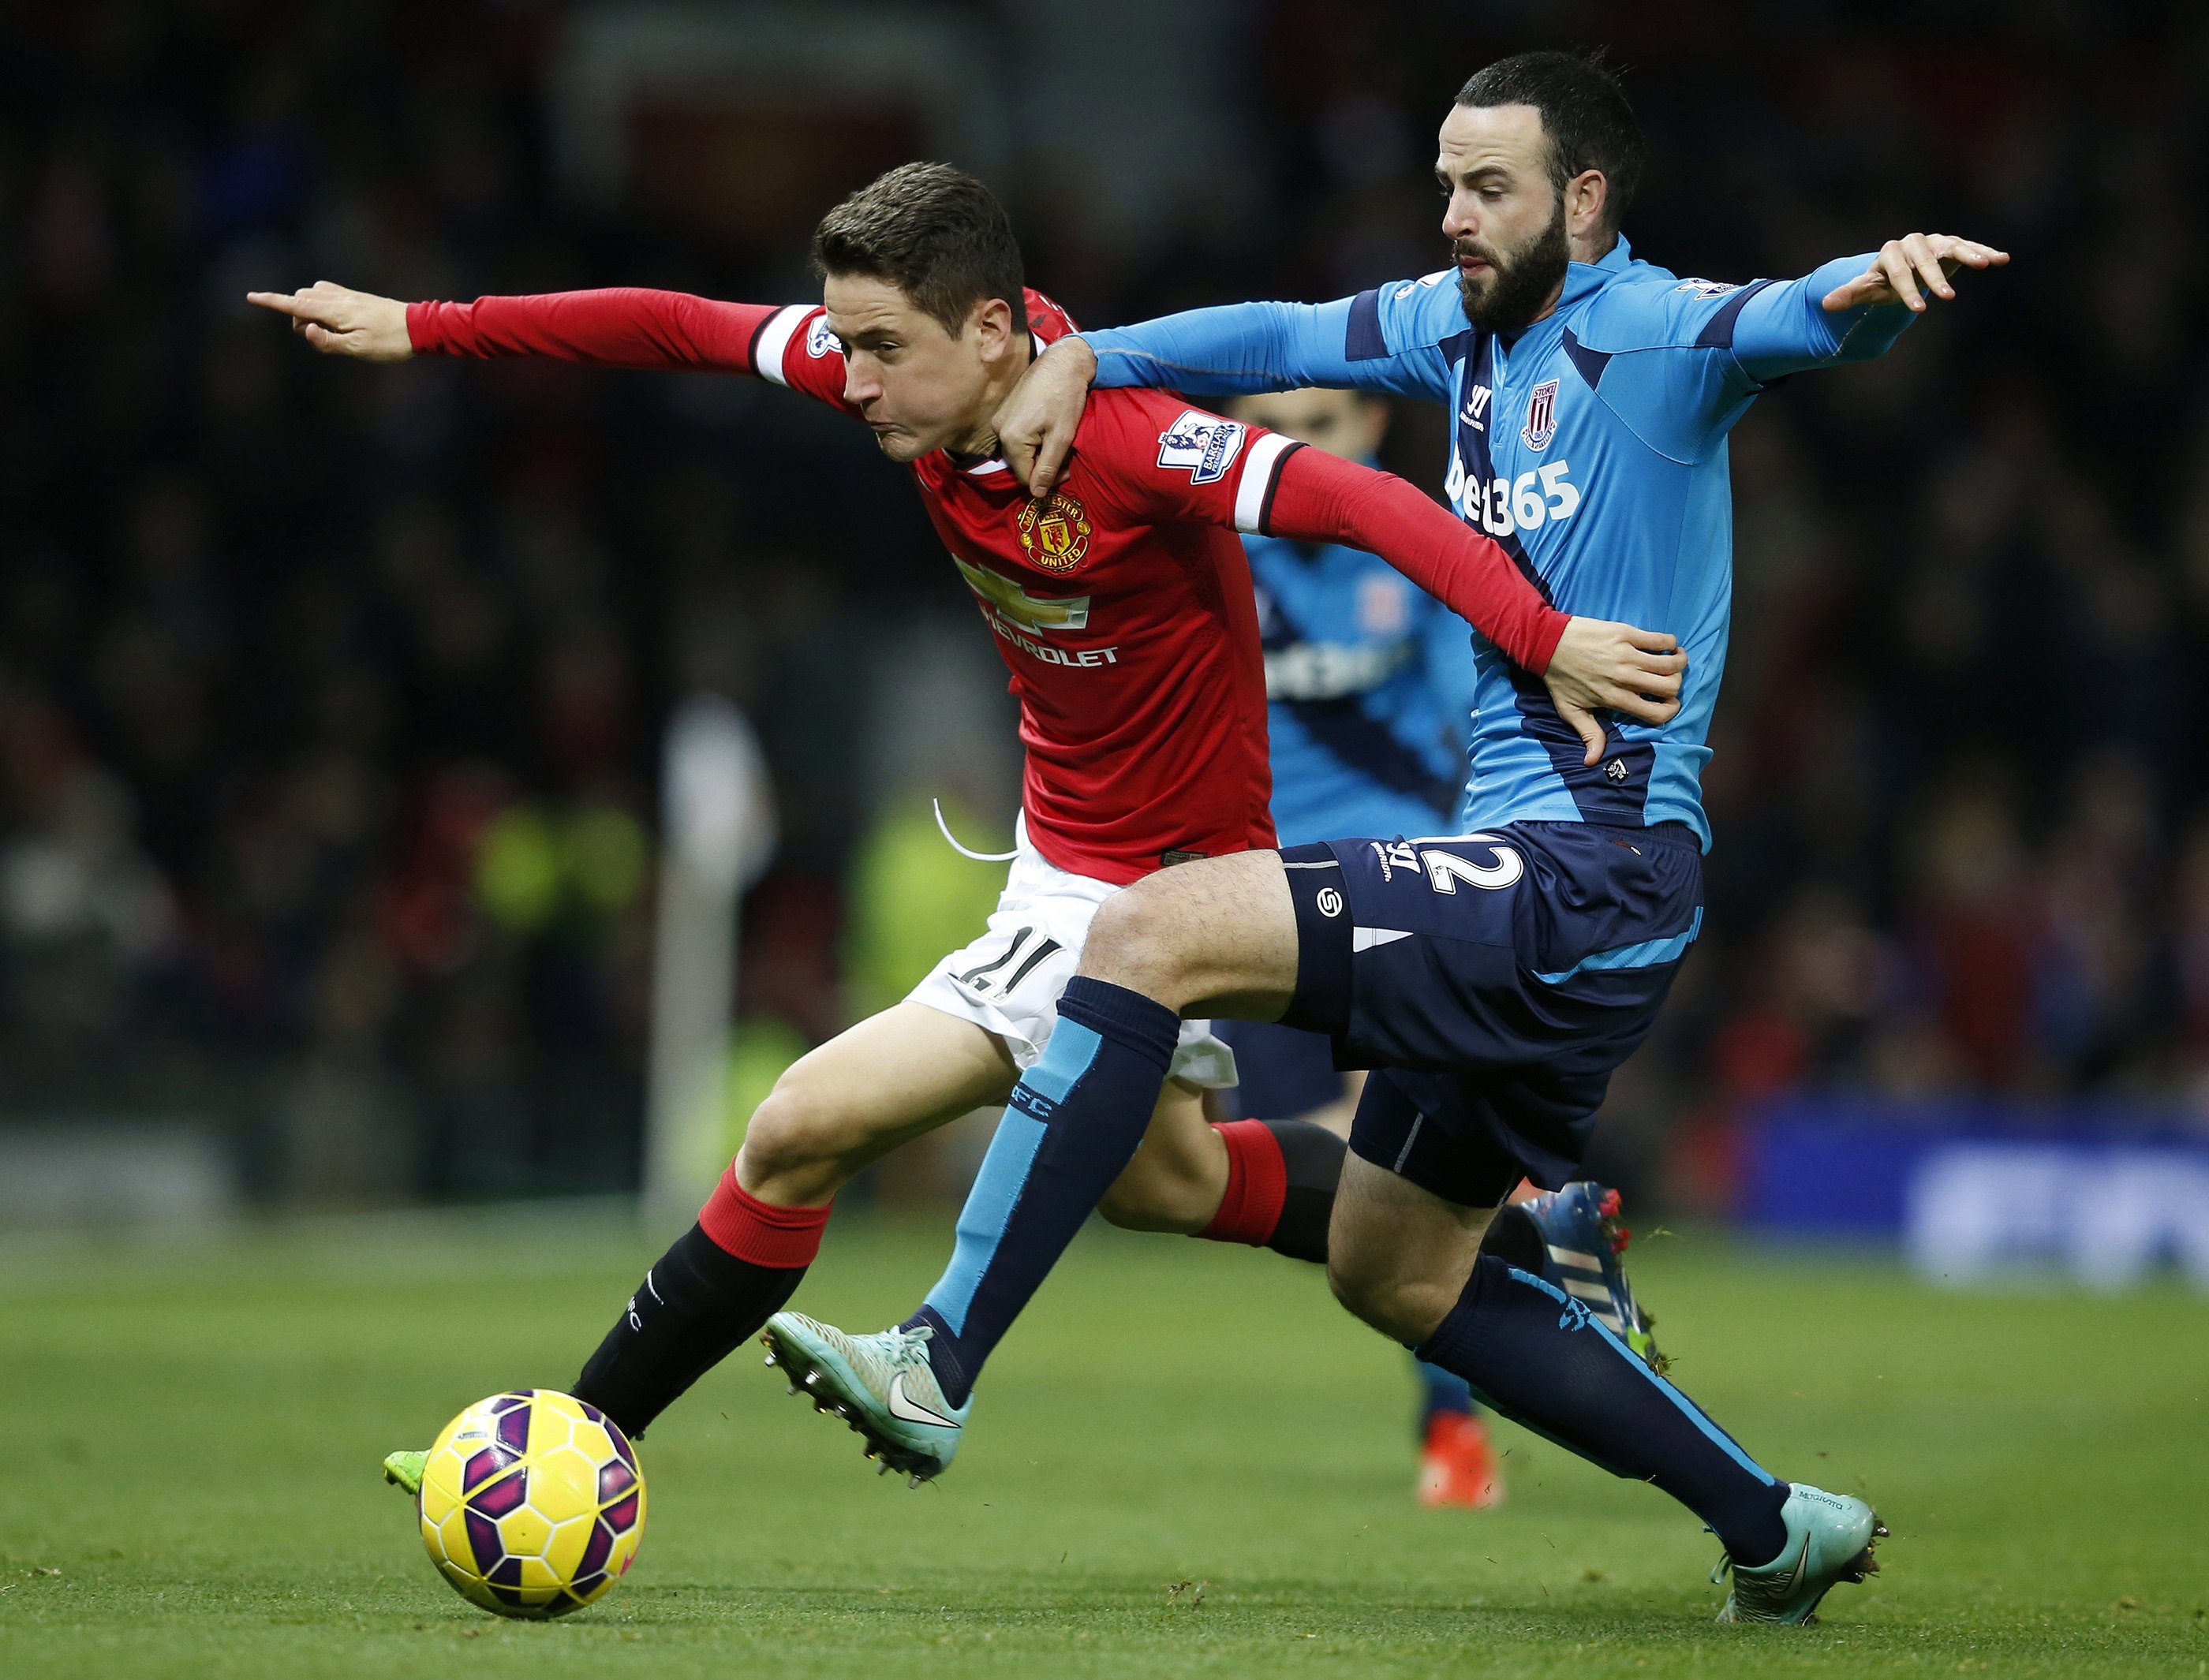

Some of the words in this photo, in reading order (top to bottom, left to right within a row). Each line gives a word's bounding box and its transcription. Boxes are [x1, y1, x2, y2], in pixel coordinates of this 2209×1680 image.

[1534, 385, 1554, 398] STOKE
[1445, 440, 1580, 537] bet365
[1041, 548, 1081, 566] UNITED
[978, 600, 1118, 667] HEVROLET
